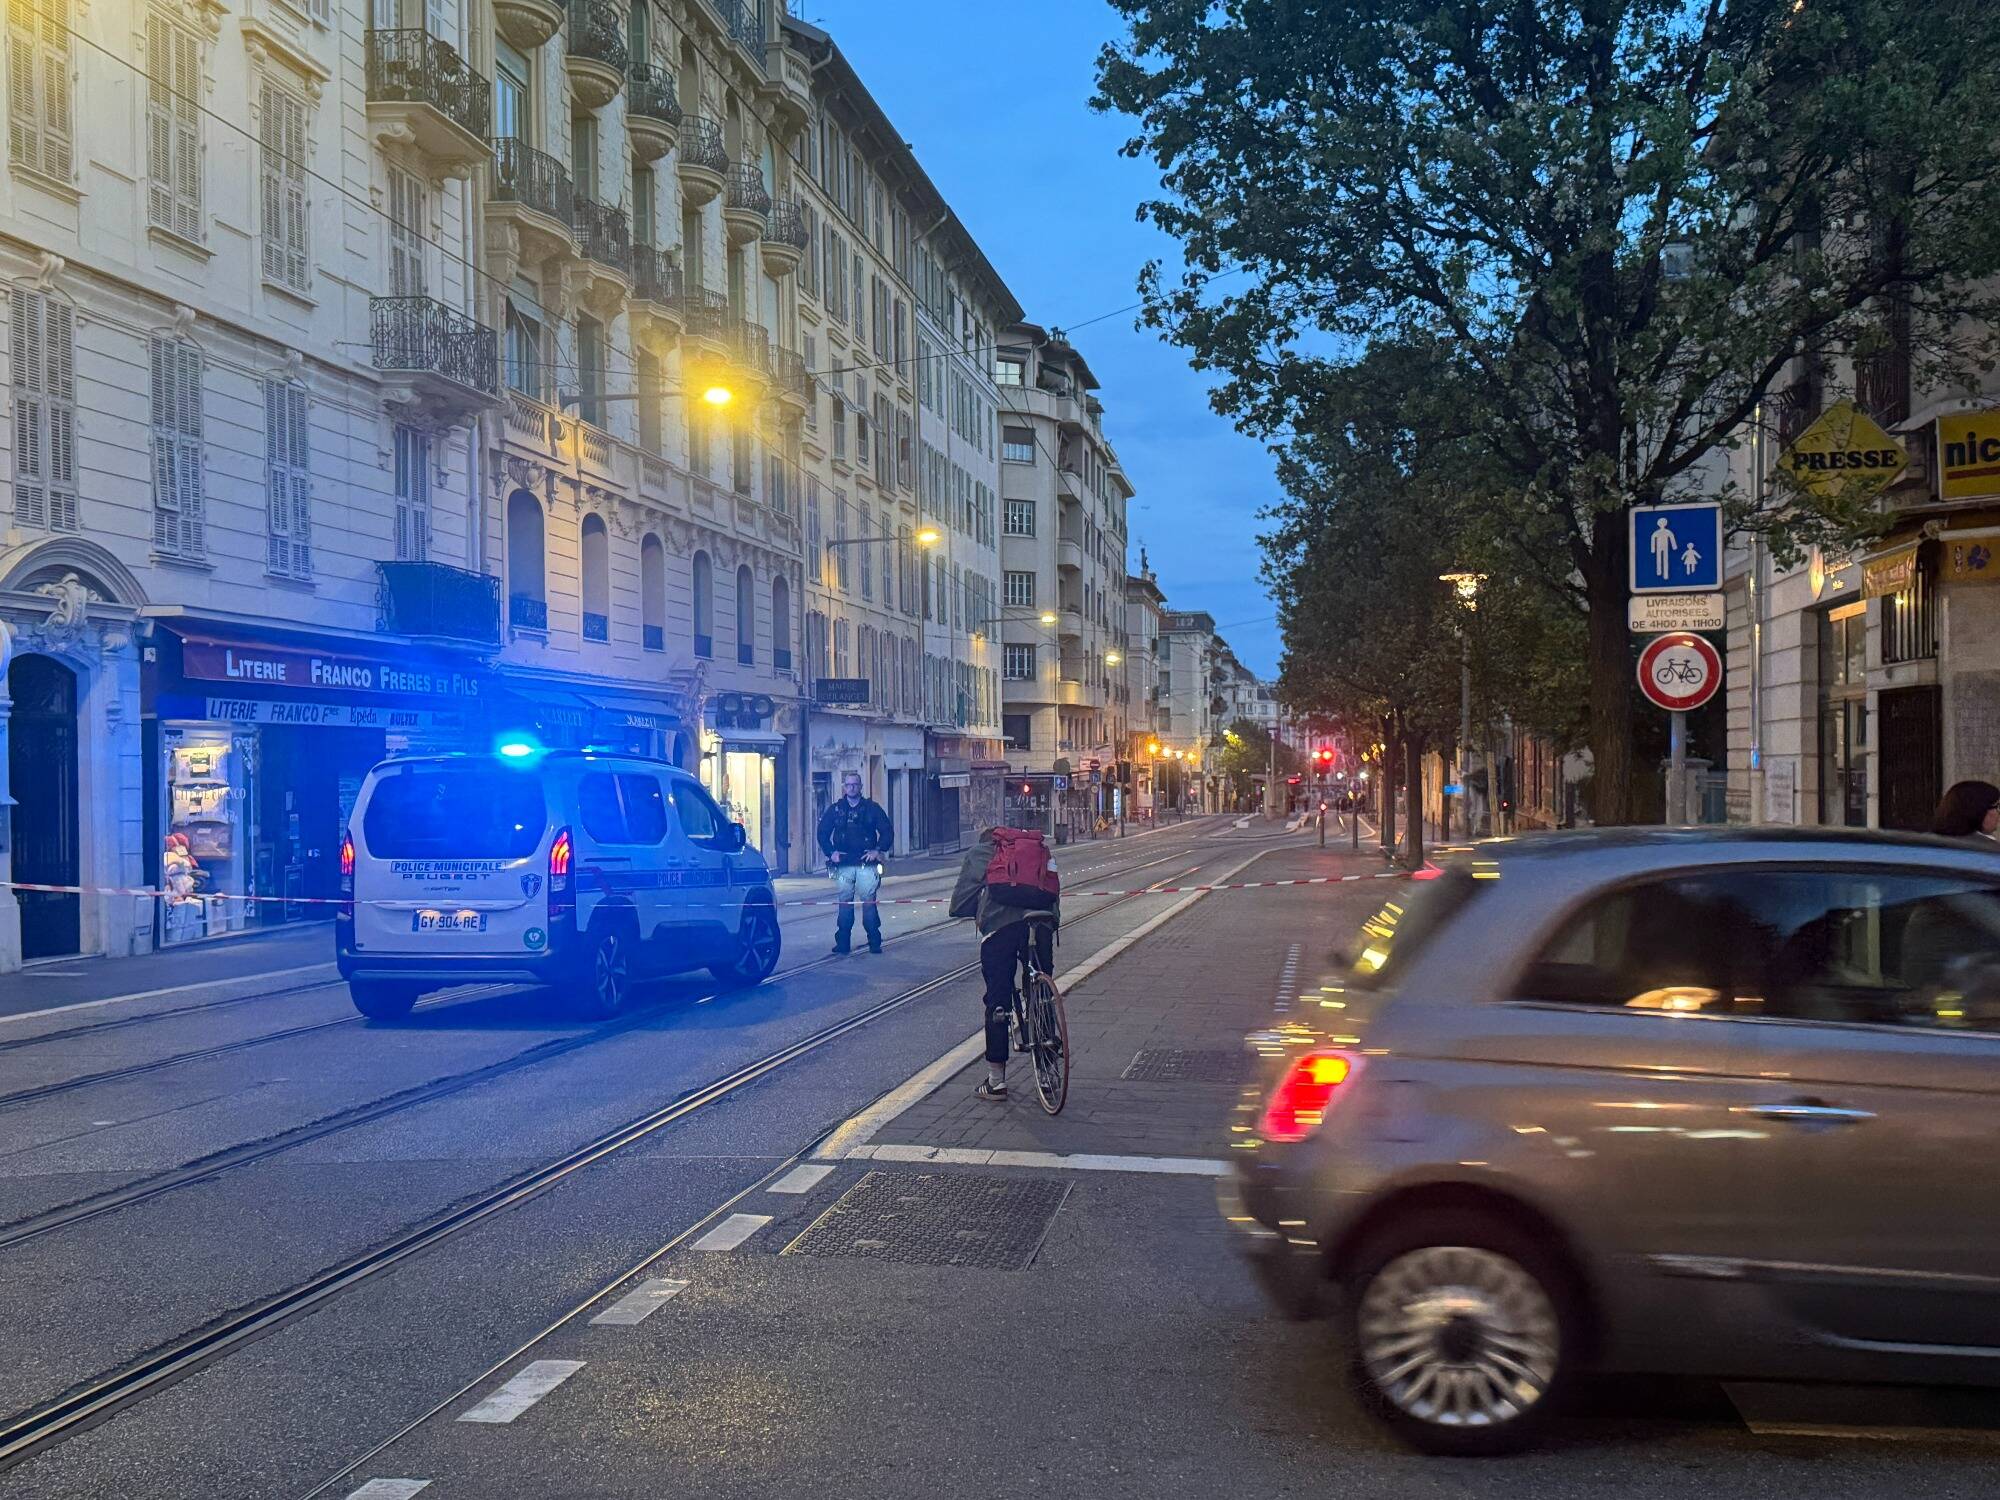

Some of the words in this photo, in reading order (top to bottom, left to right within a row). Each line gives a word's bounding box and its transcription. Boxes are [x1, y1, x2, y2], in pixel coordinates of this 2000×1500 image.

[1792, 450, 1898, 470] PRESSE
[1646, 597, 1707, 608] LIVRAISONS
[1646, 608, 1709, 618] AUTORISEES
[1632, 620, 1646, 629] DE
[1649, 620, 1677, 628] 4H00
[1681, 619, 1688, 628] A
[1693, 618, 1721, 628] 11H00
[226, 650, 286, 681] LITERIE
[310, 659, 371, 688] FRANCO
[436, 679, 448, 693] ET
[453, 673, 478, 696] FILS
[210, 699, 258, 720] LITERIE
[270, 703, 319, 722] FRANCO
[394, 862, 430, 871] POLICE
[433, 862, 503, 871] MUNICIPALE
